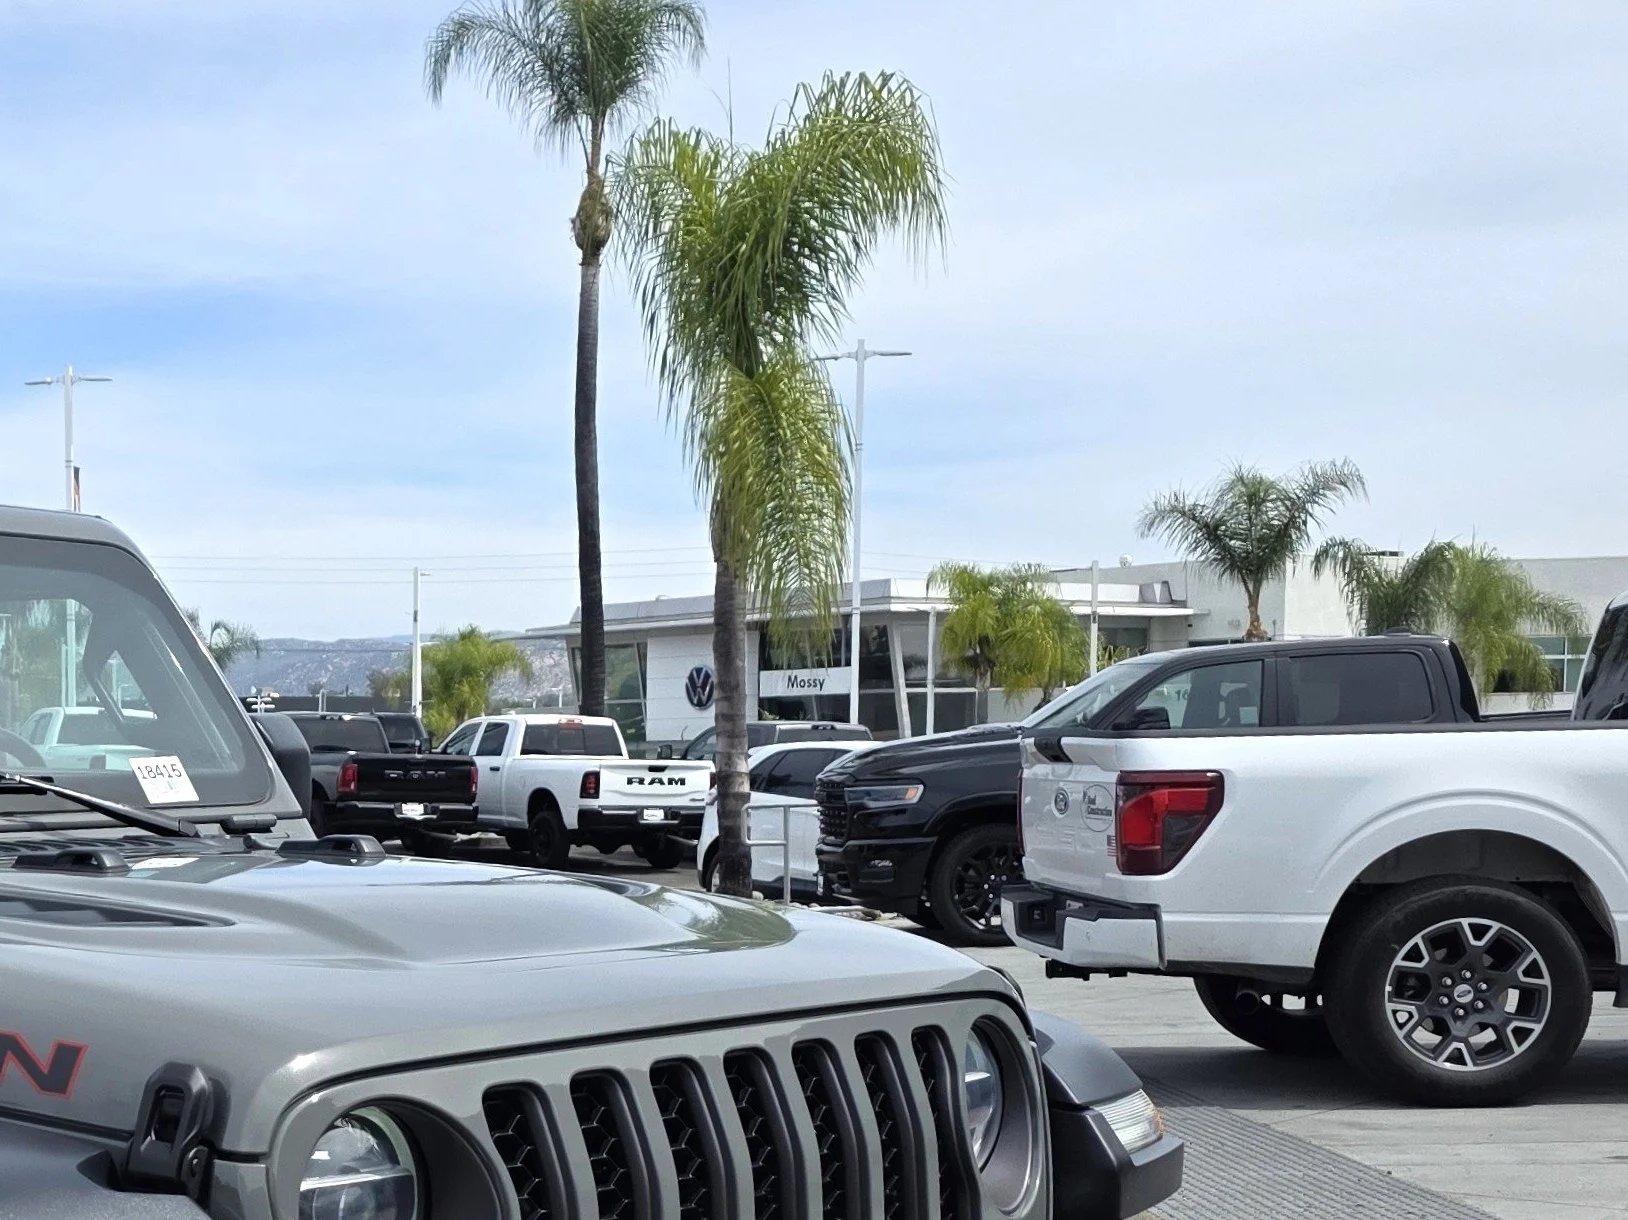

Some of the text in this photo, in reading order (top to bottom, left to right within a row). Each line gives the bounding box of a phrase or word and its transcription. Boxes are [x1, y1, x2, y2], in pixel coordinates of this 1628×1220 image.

[787, 675, 826, 692] Mossy
[137, 763, 183, 780] 18415
[626, 776, 686, 786] RAM
